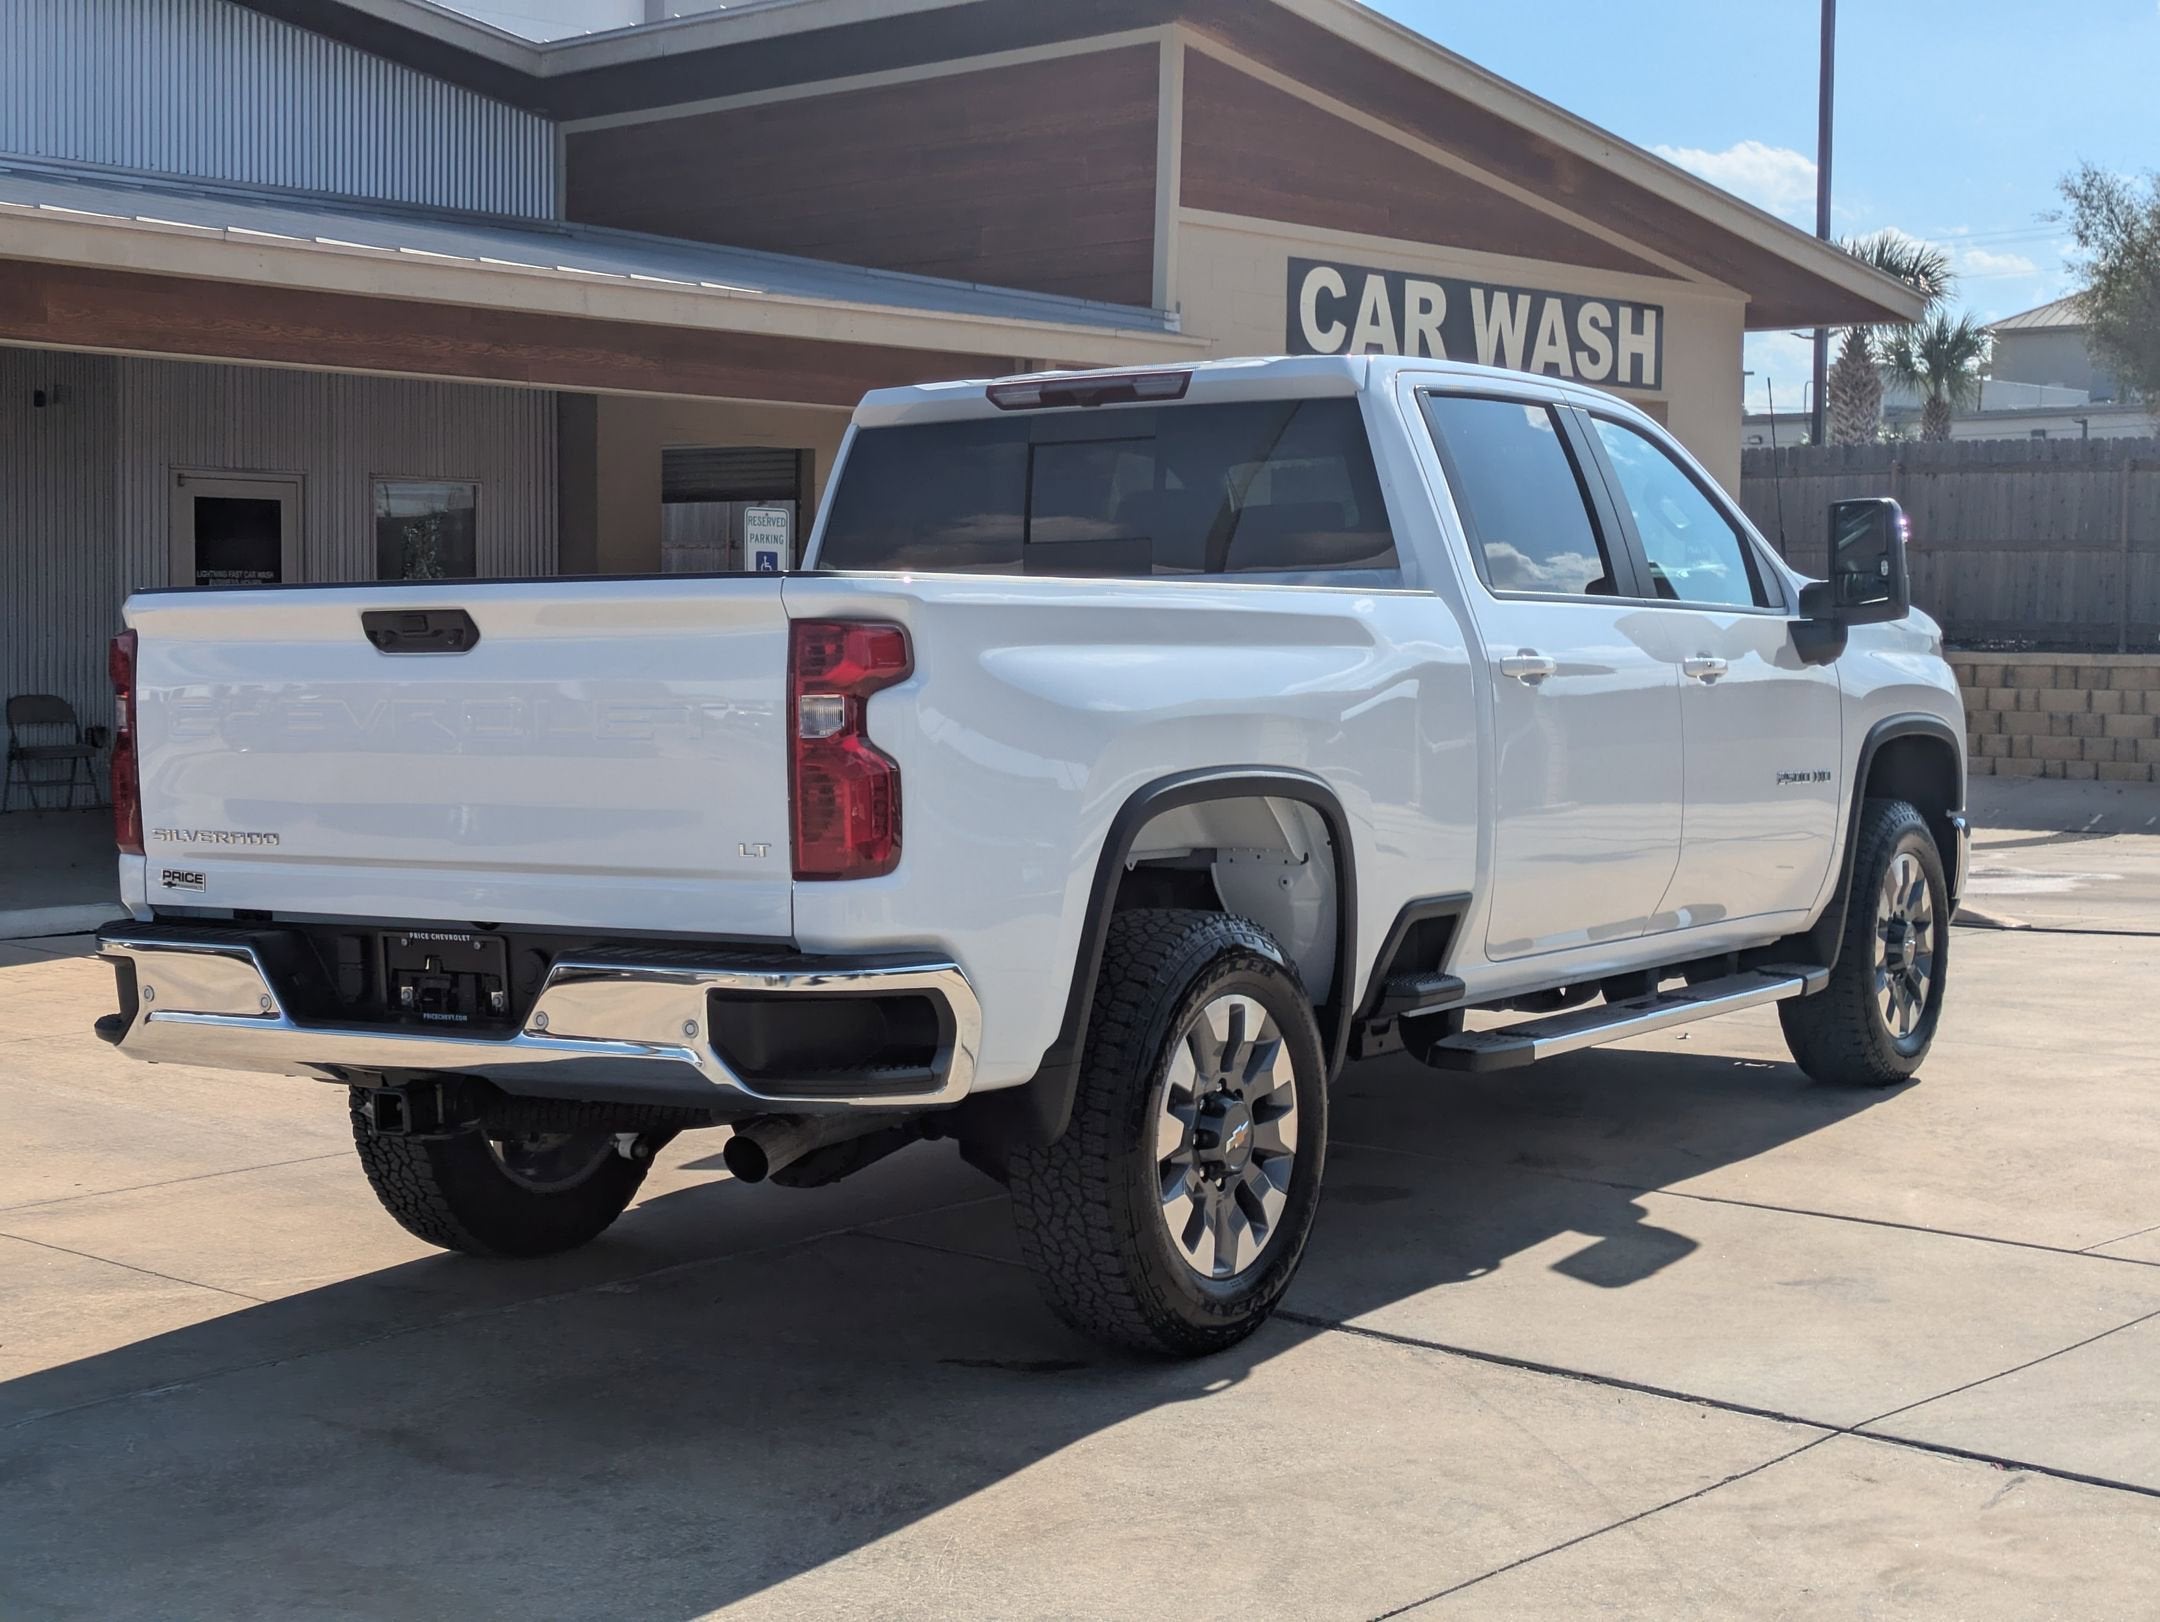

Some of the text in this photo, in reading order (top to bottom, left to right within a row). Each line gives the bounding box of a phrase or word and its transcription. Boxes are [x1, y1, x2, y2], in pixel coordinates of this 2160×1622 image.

[1299, 266, 1657, 386] CAR WASH
[747, 515, 786, 528] RESERVED
[749, 533, 785, 545] PARKING
[228, 570, 243, 578] FAST
[244, 570, 256, 578] CAR
[152, 828, 281, 846] SILVERADO
[738, 842, 772, 858] LT
[162, 869, 204, 885] PRICE
[409, 932, 471, 941] PRICE CHEVROLET
